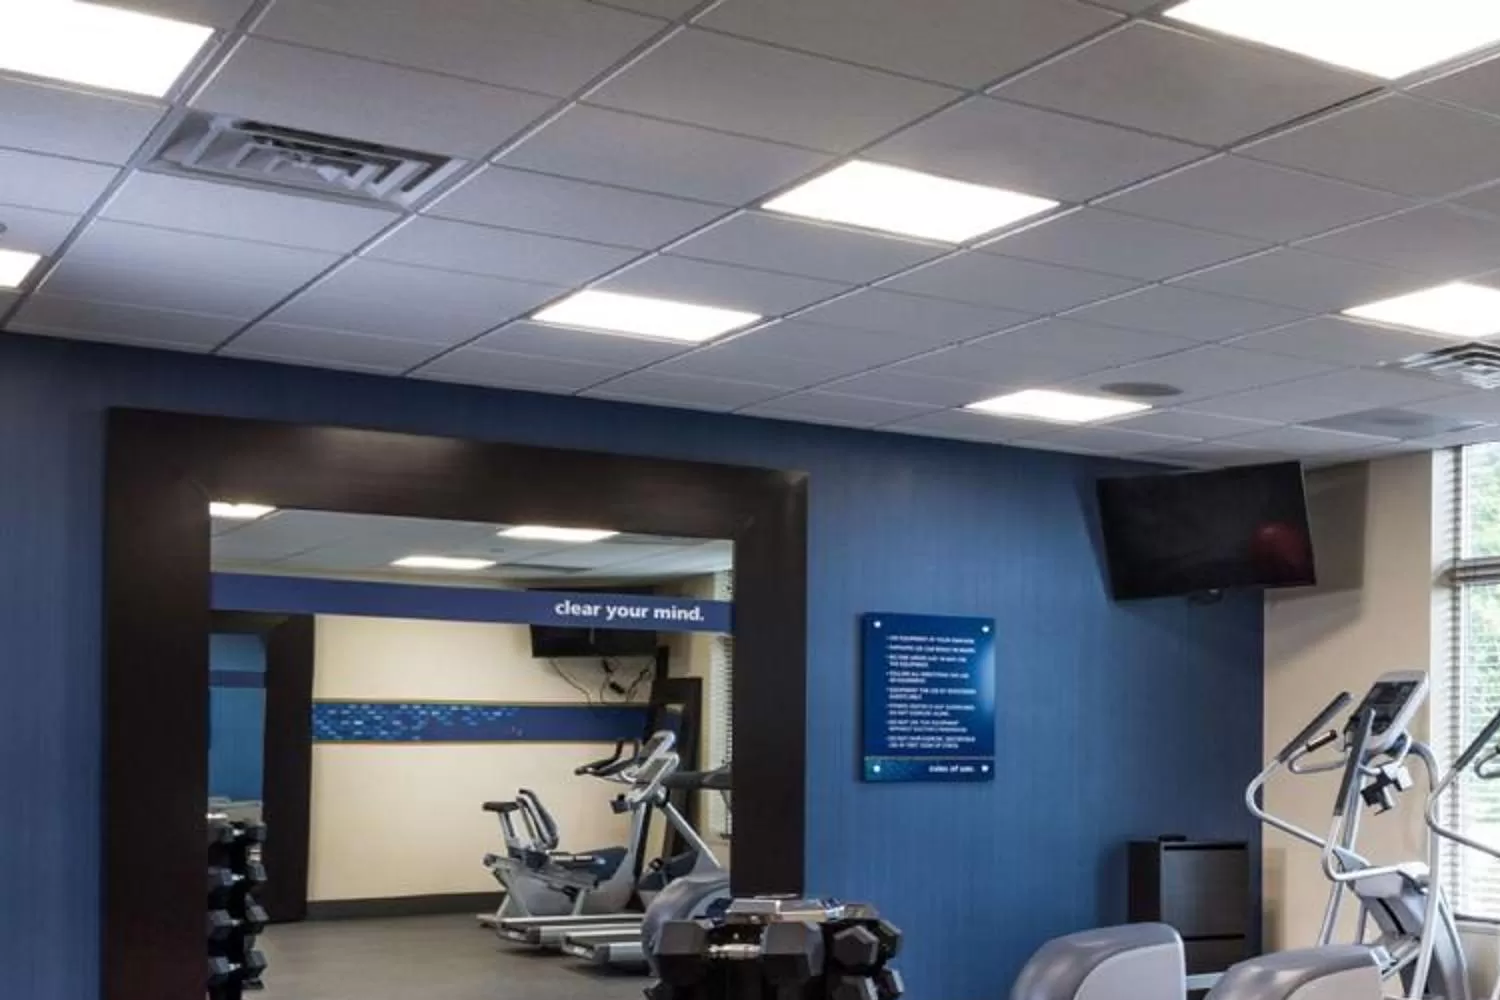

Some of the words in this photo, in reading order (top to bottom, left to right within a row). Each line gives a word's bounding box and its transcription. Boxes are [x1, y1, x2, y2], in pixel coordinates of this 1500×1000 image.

[555, 600, 601, 616] clear
[605, 604, 649, 620] your
[653, 605, 704, 621] mind.
